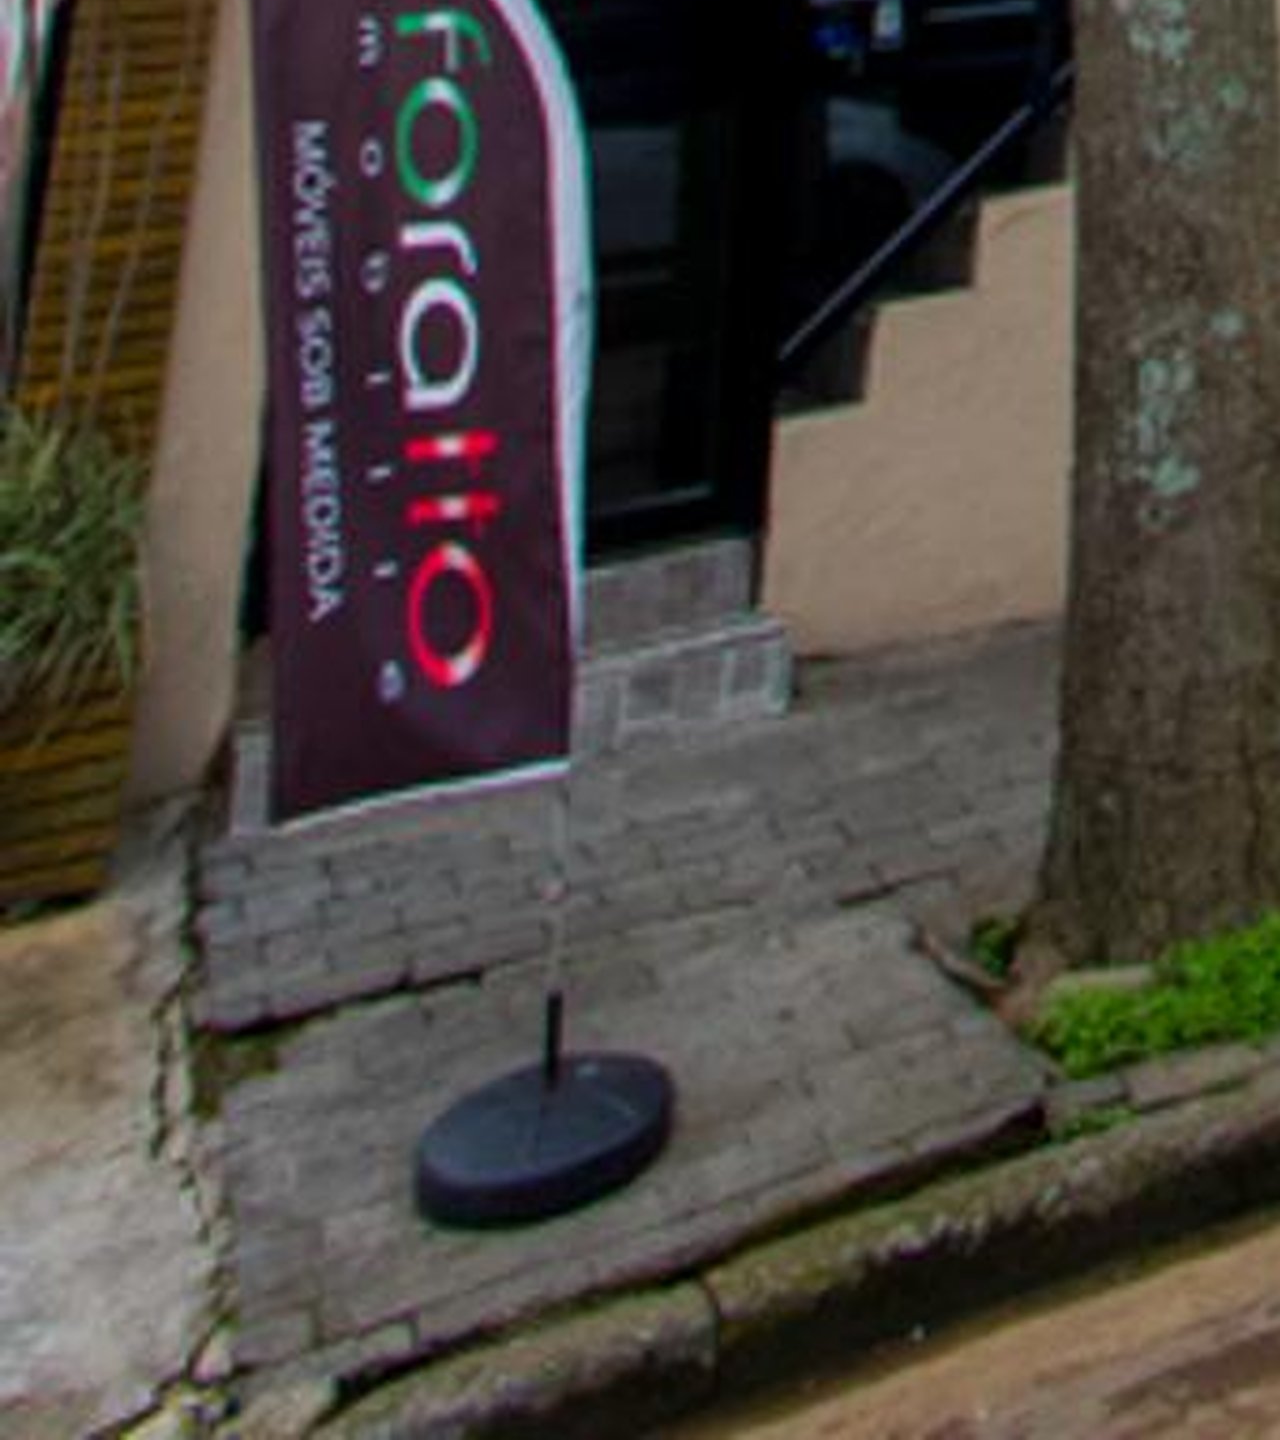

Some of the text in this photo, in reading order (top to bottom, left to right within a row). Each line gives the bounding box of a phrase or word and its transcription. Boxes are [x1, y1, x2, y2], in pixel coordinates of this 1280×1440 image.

[294, 120, 343, 622] MÓVEIS SOB MEDIDA
[395, 9, 499, 686] foratto
